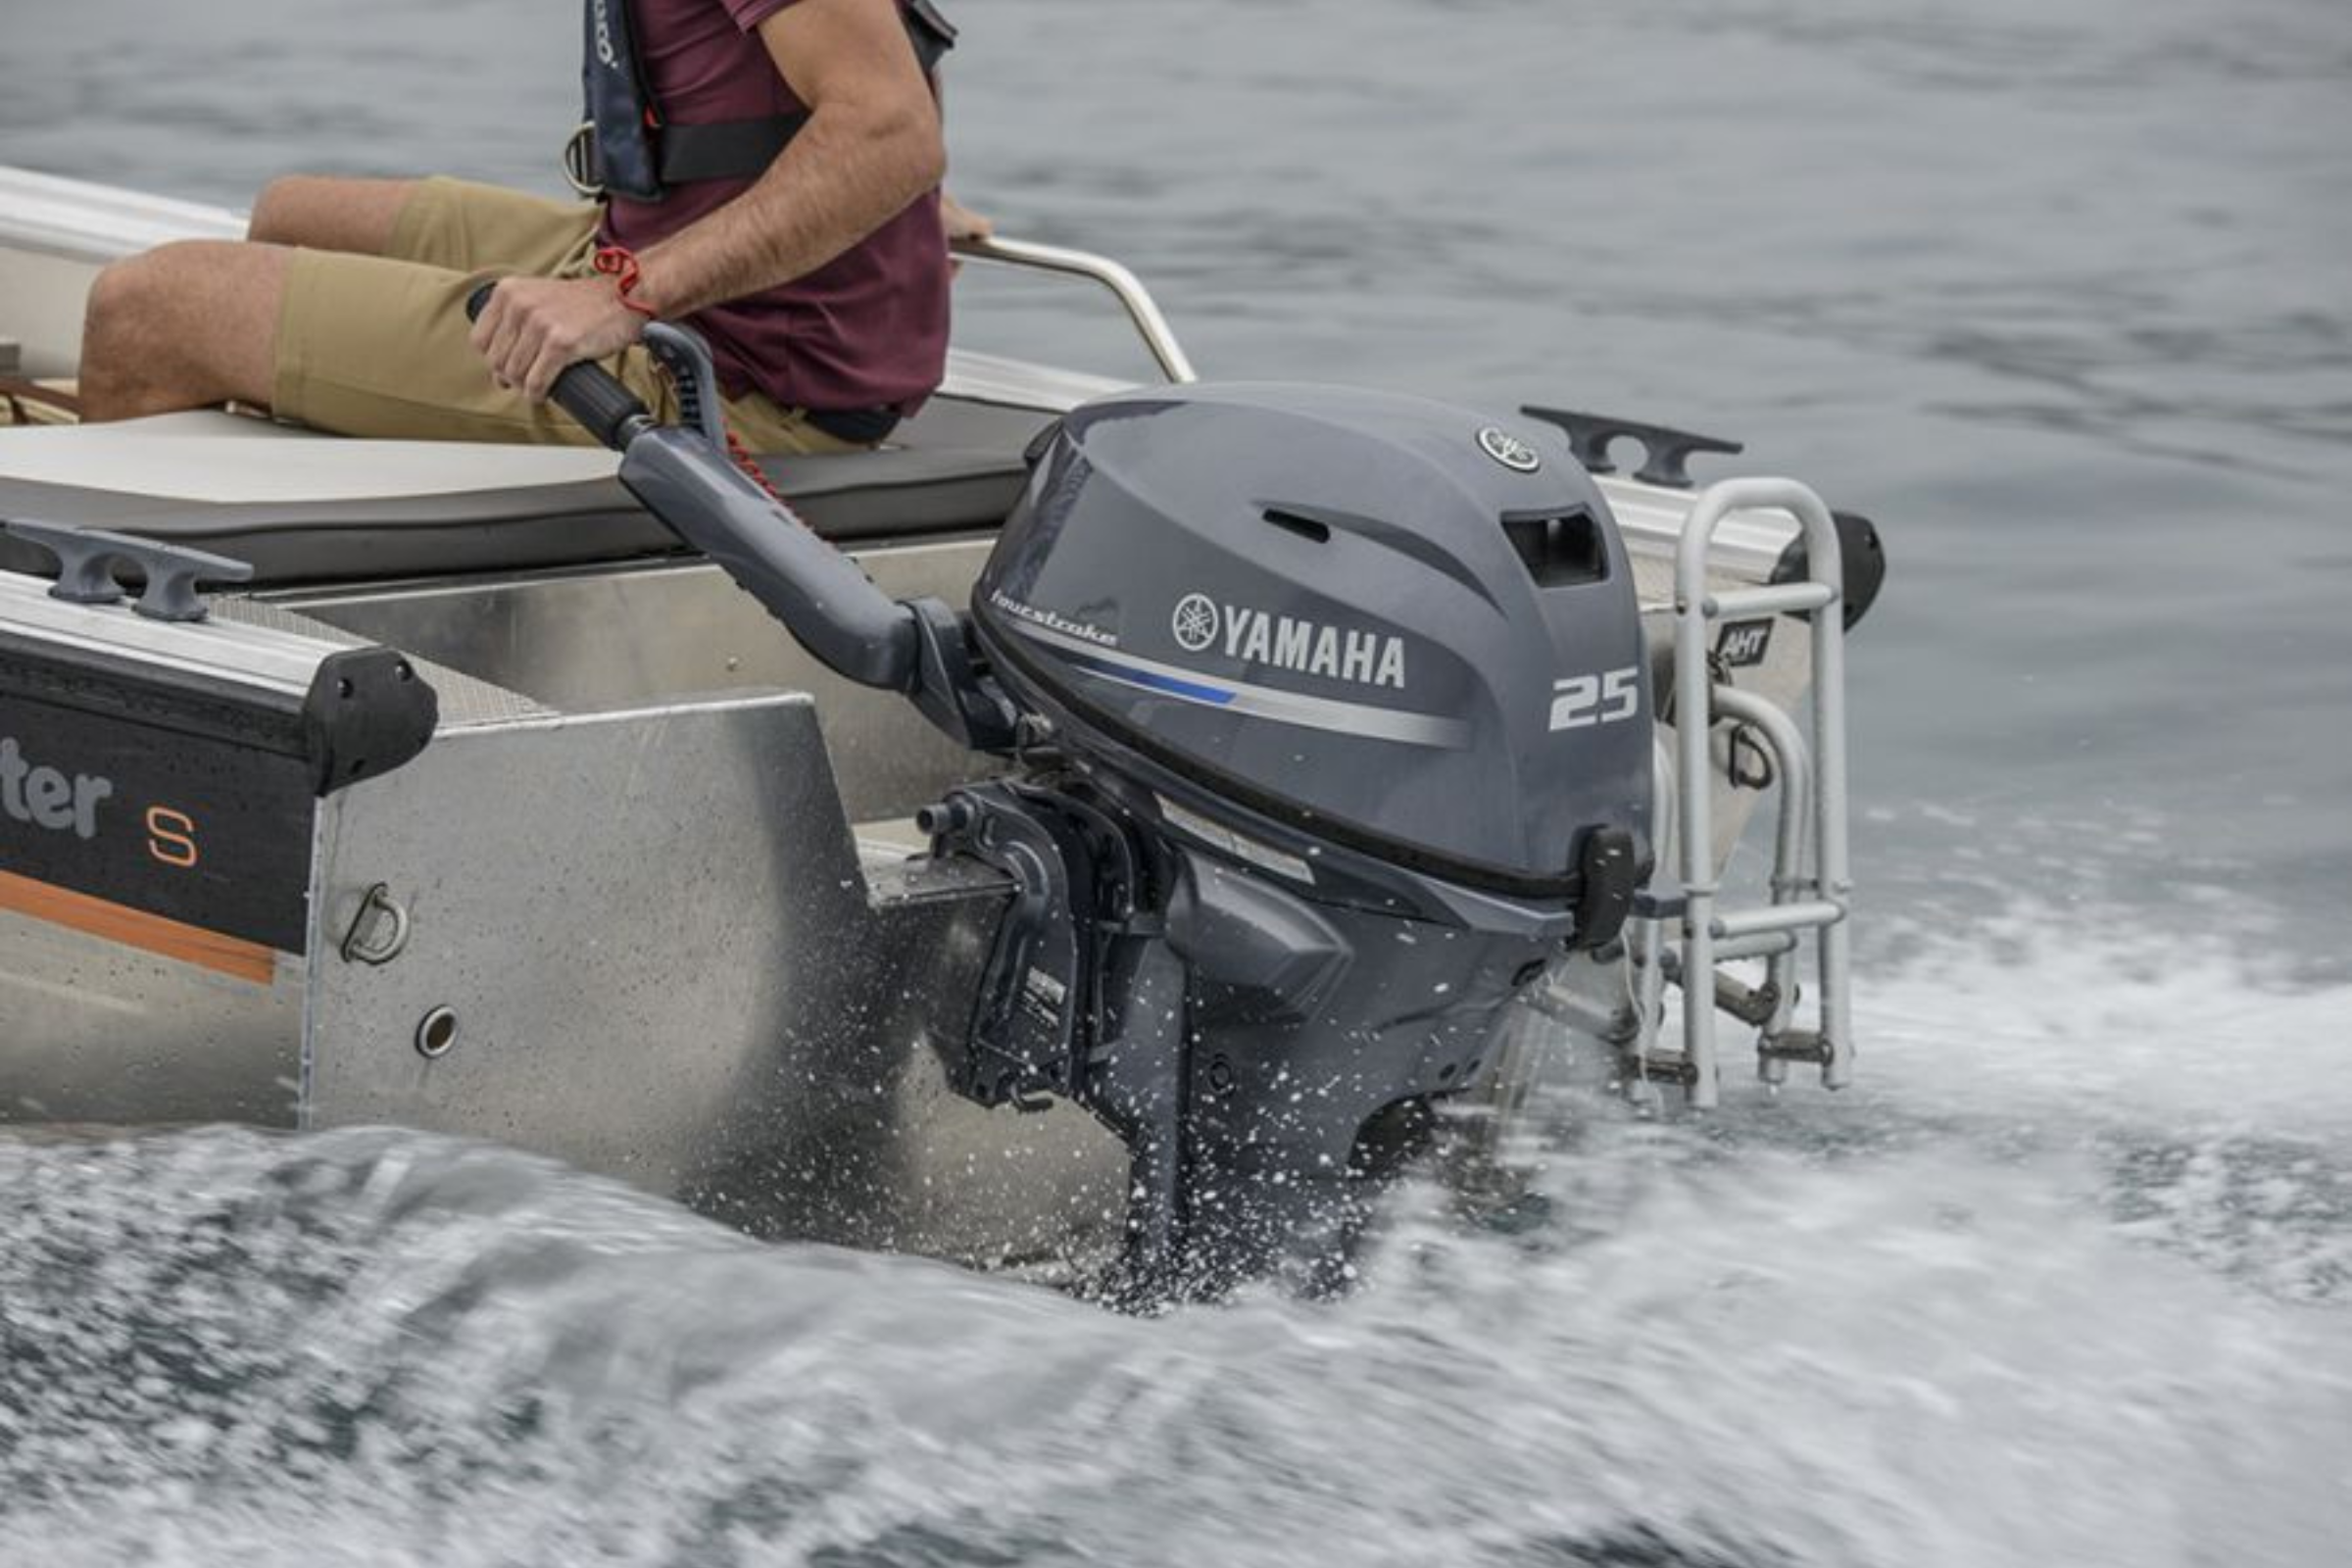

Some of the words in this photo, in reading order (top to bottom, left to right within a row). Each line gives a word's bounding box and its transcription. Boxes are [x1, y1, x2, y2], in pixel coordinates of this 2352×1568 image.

[1225, 606, 1404, 688] YAMAHA
[1548, 666, 1638, 732] 25
[0, 737, 113, 839] ter
[147, 806, 196, 867] S
